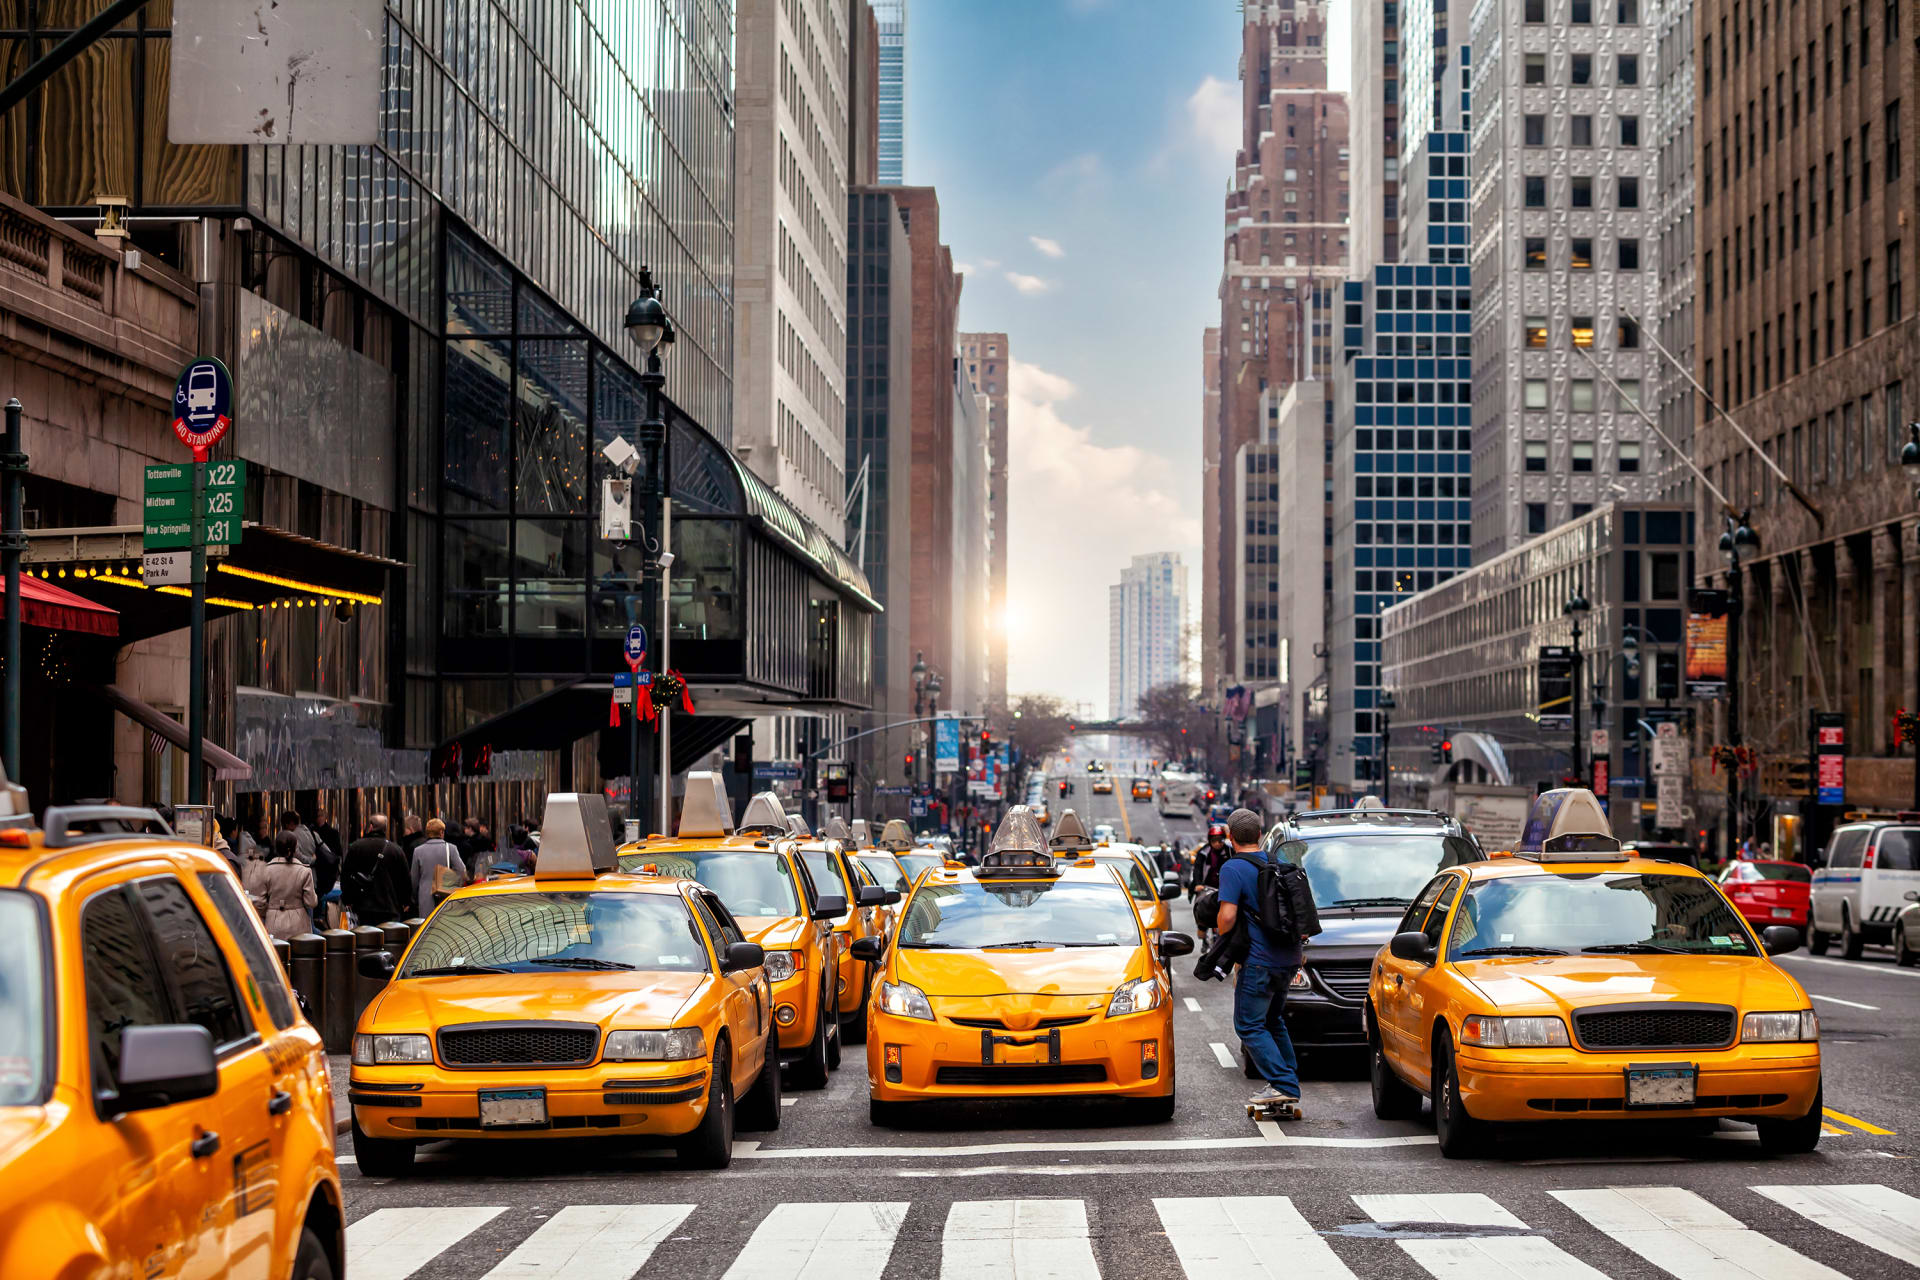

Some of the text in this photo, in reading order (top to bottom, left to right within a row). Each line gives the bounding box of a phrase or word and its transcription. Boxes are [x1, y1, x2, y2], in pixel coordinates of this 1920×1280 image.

[176, 418, 225, 446] NO STANDING
[147, 469, 182, 480] Tottenville
[208, 464, 236, 486] x22
[146, 496, 176, 507] Midtown
[208, 492, 233, 514] x25
[146, 523, 191, 536] New Springville
[207, 520, 230, 542] x31
[146, 556, 174, 566] E 42 St &
[146, 569, 160, 578] Park
